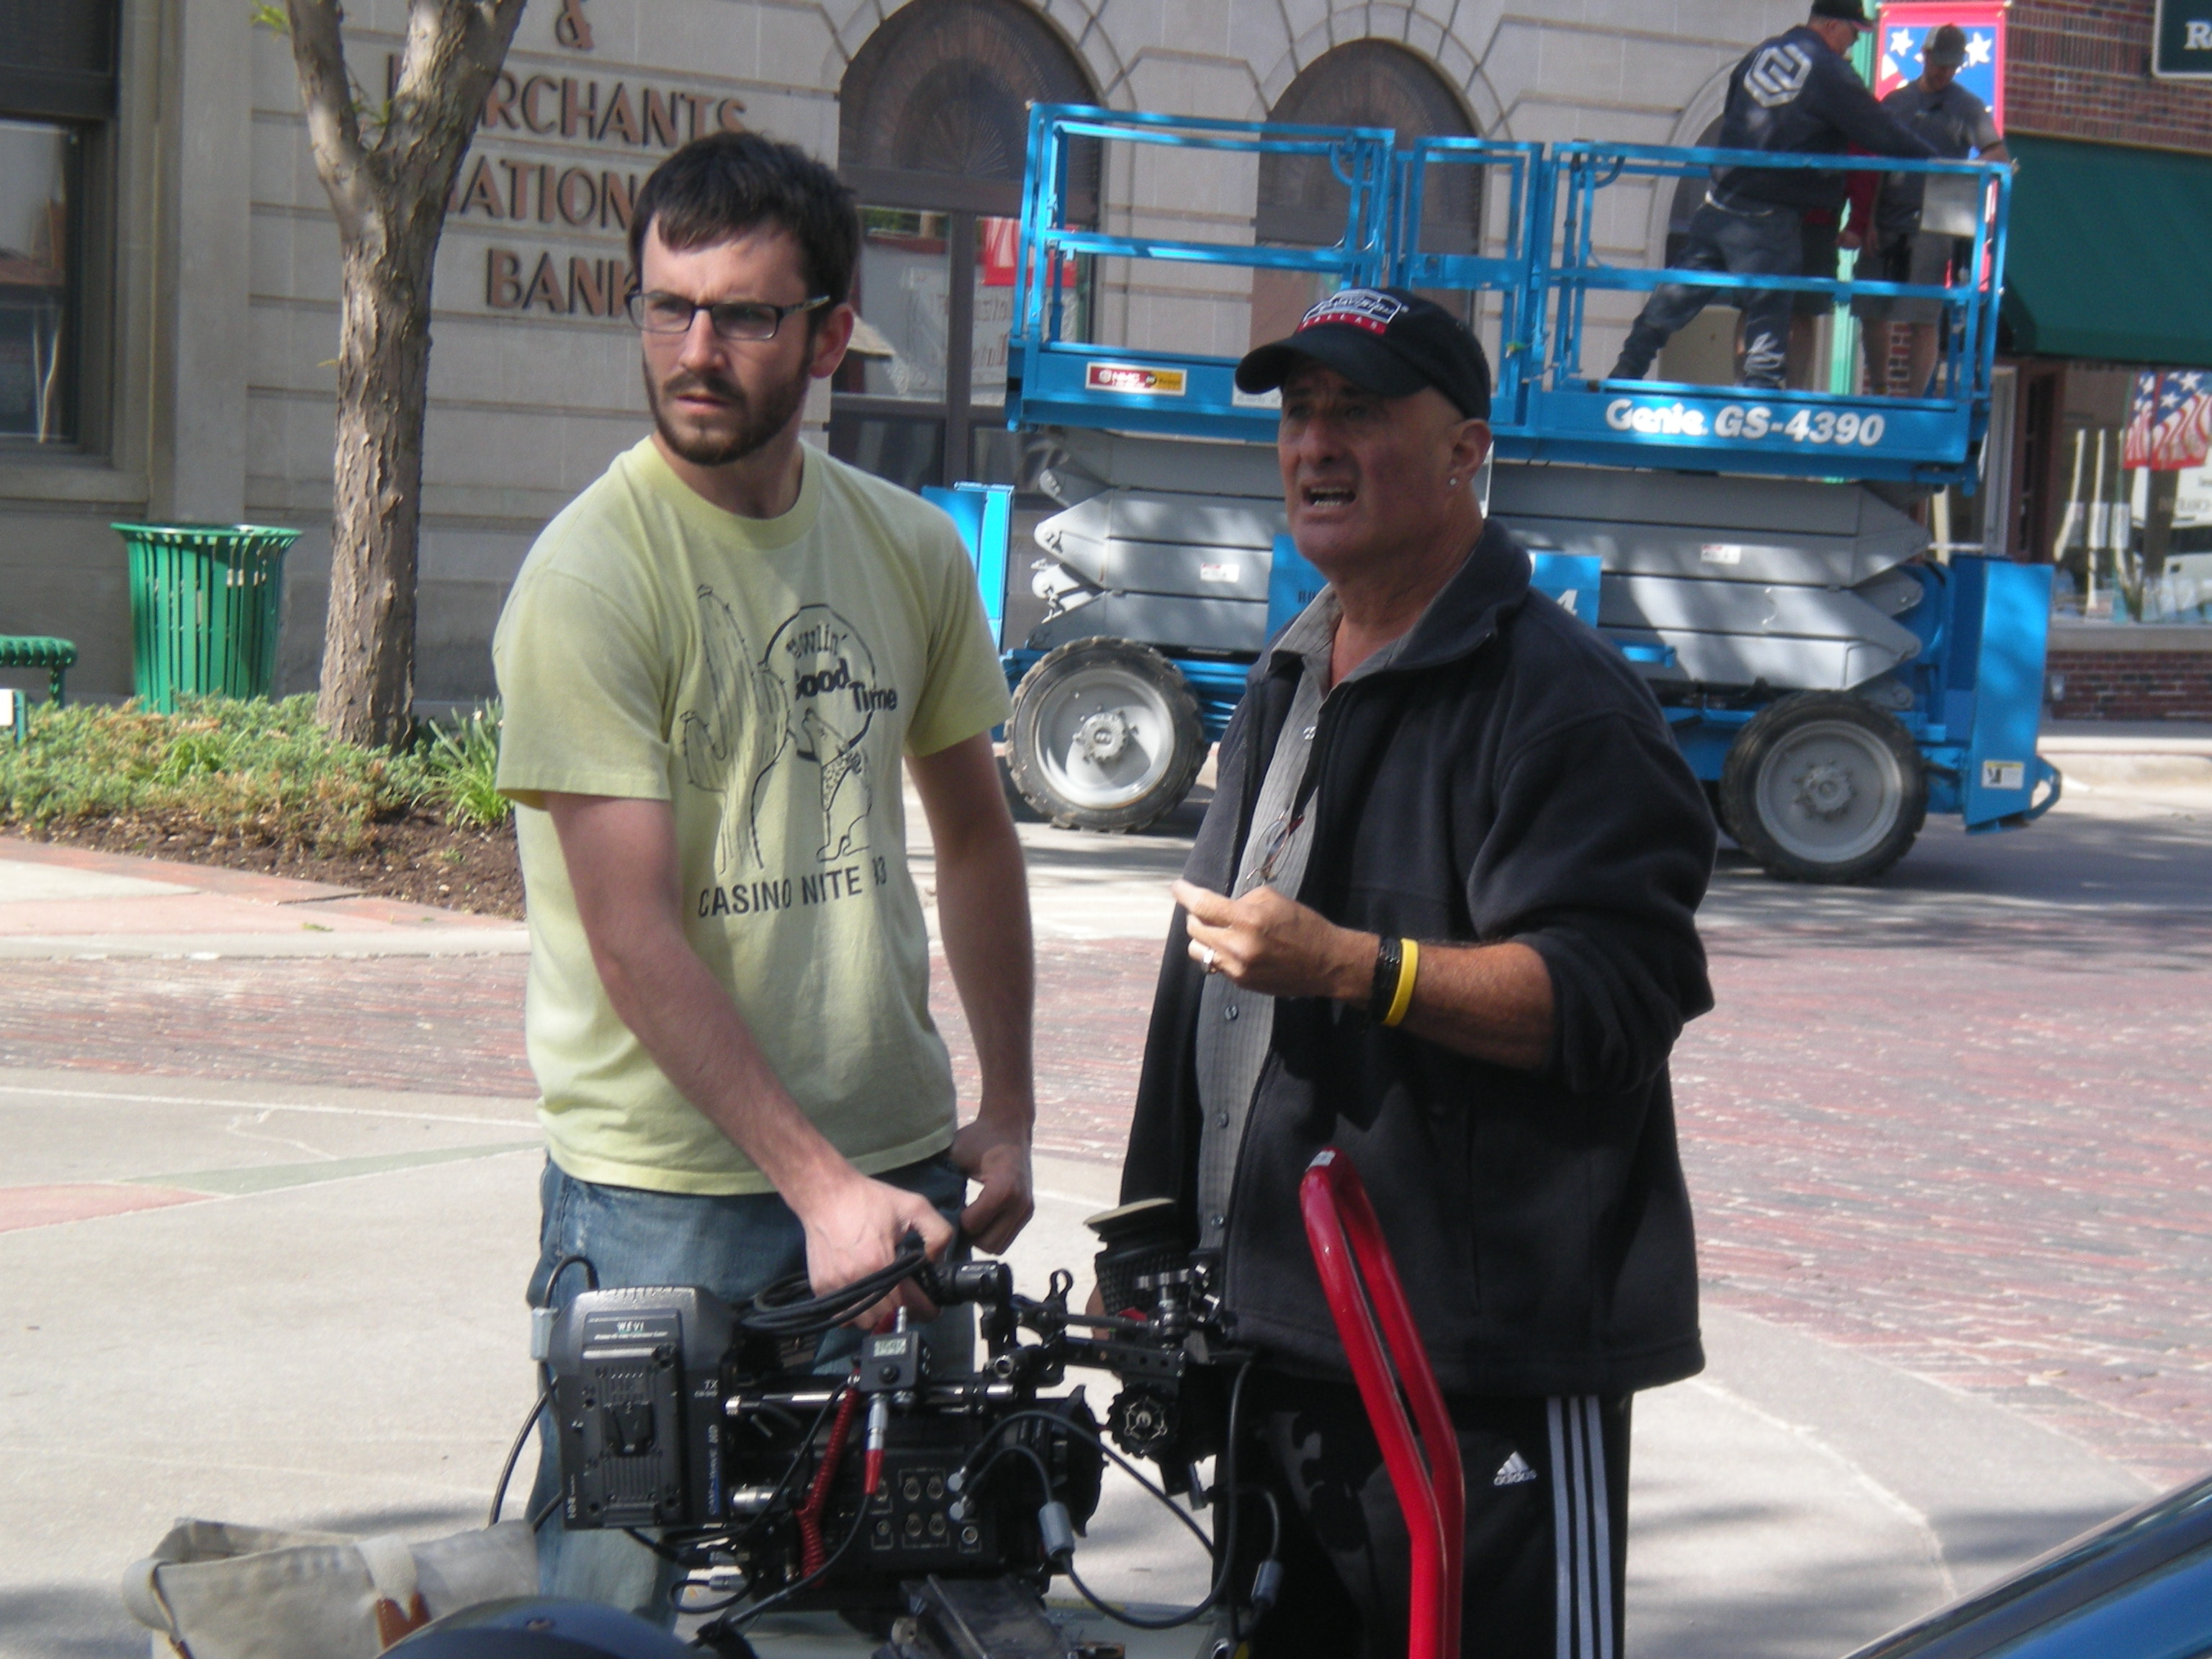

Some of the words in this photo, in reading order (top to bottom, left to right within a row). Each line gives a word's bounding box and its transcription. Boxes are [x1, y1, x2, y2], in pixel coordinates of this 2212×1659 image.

[555, 0, 595, 50] &
[2184, 20, 2212, 50] R
[387, 53, 746, 148] RCHANTS
[445, 154, 637, 228] ATION
[1606, 398, 1705, 436] Genie
[1714, 405, 1885, 446] GS-4390
[848, 680, 898, 713] Time
[697, 878, 792, 918] CASINO
[801, 865, 863, 906] NITE
